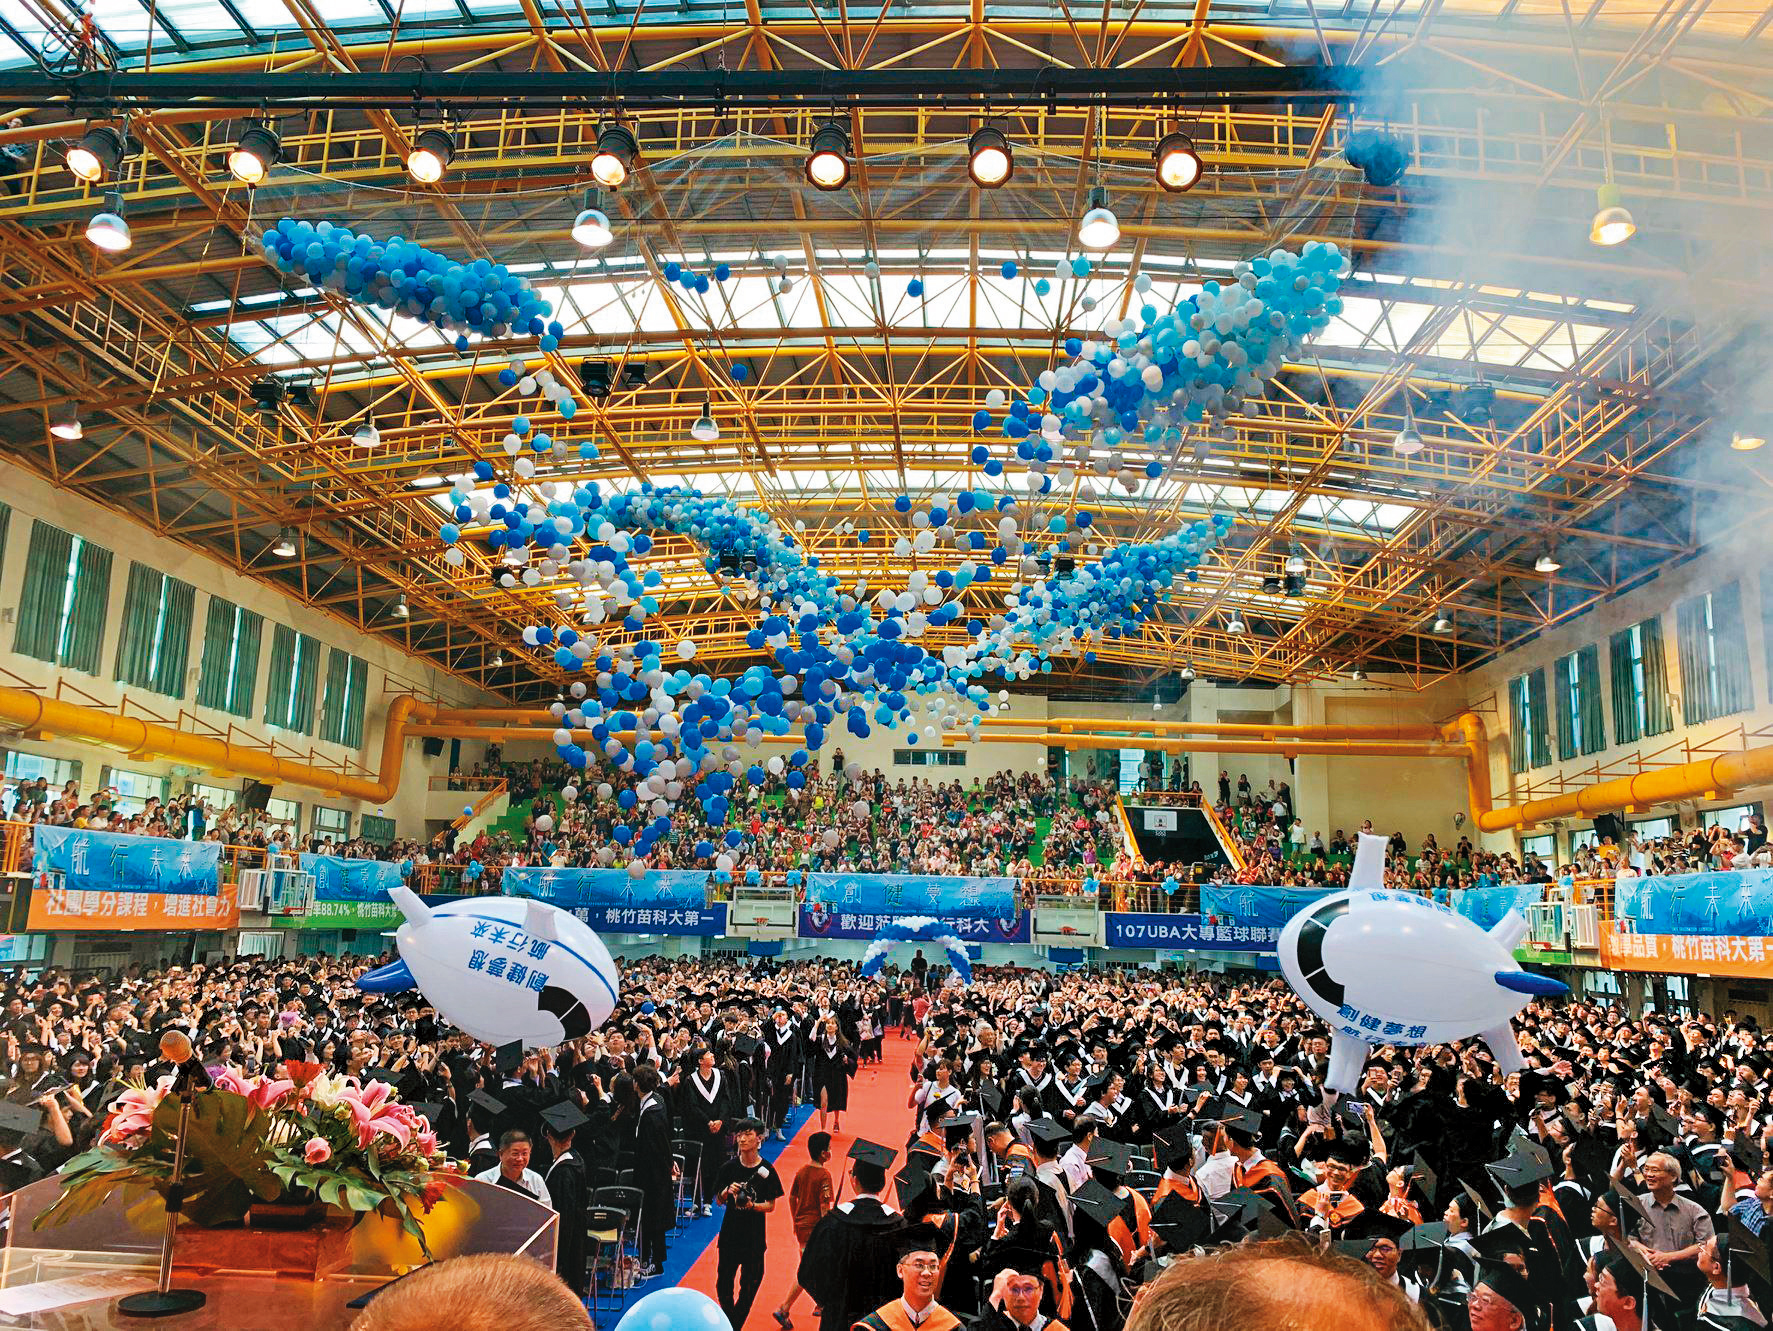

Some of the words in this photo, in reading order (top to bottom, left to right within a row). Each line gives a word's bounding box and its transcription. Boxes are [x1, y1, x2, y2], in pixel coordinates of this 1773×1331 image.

[567, 907, 714, 926] 萬，桃竹苗科大第一
